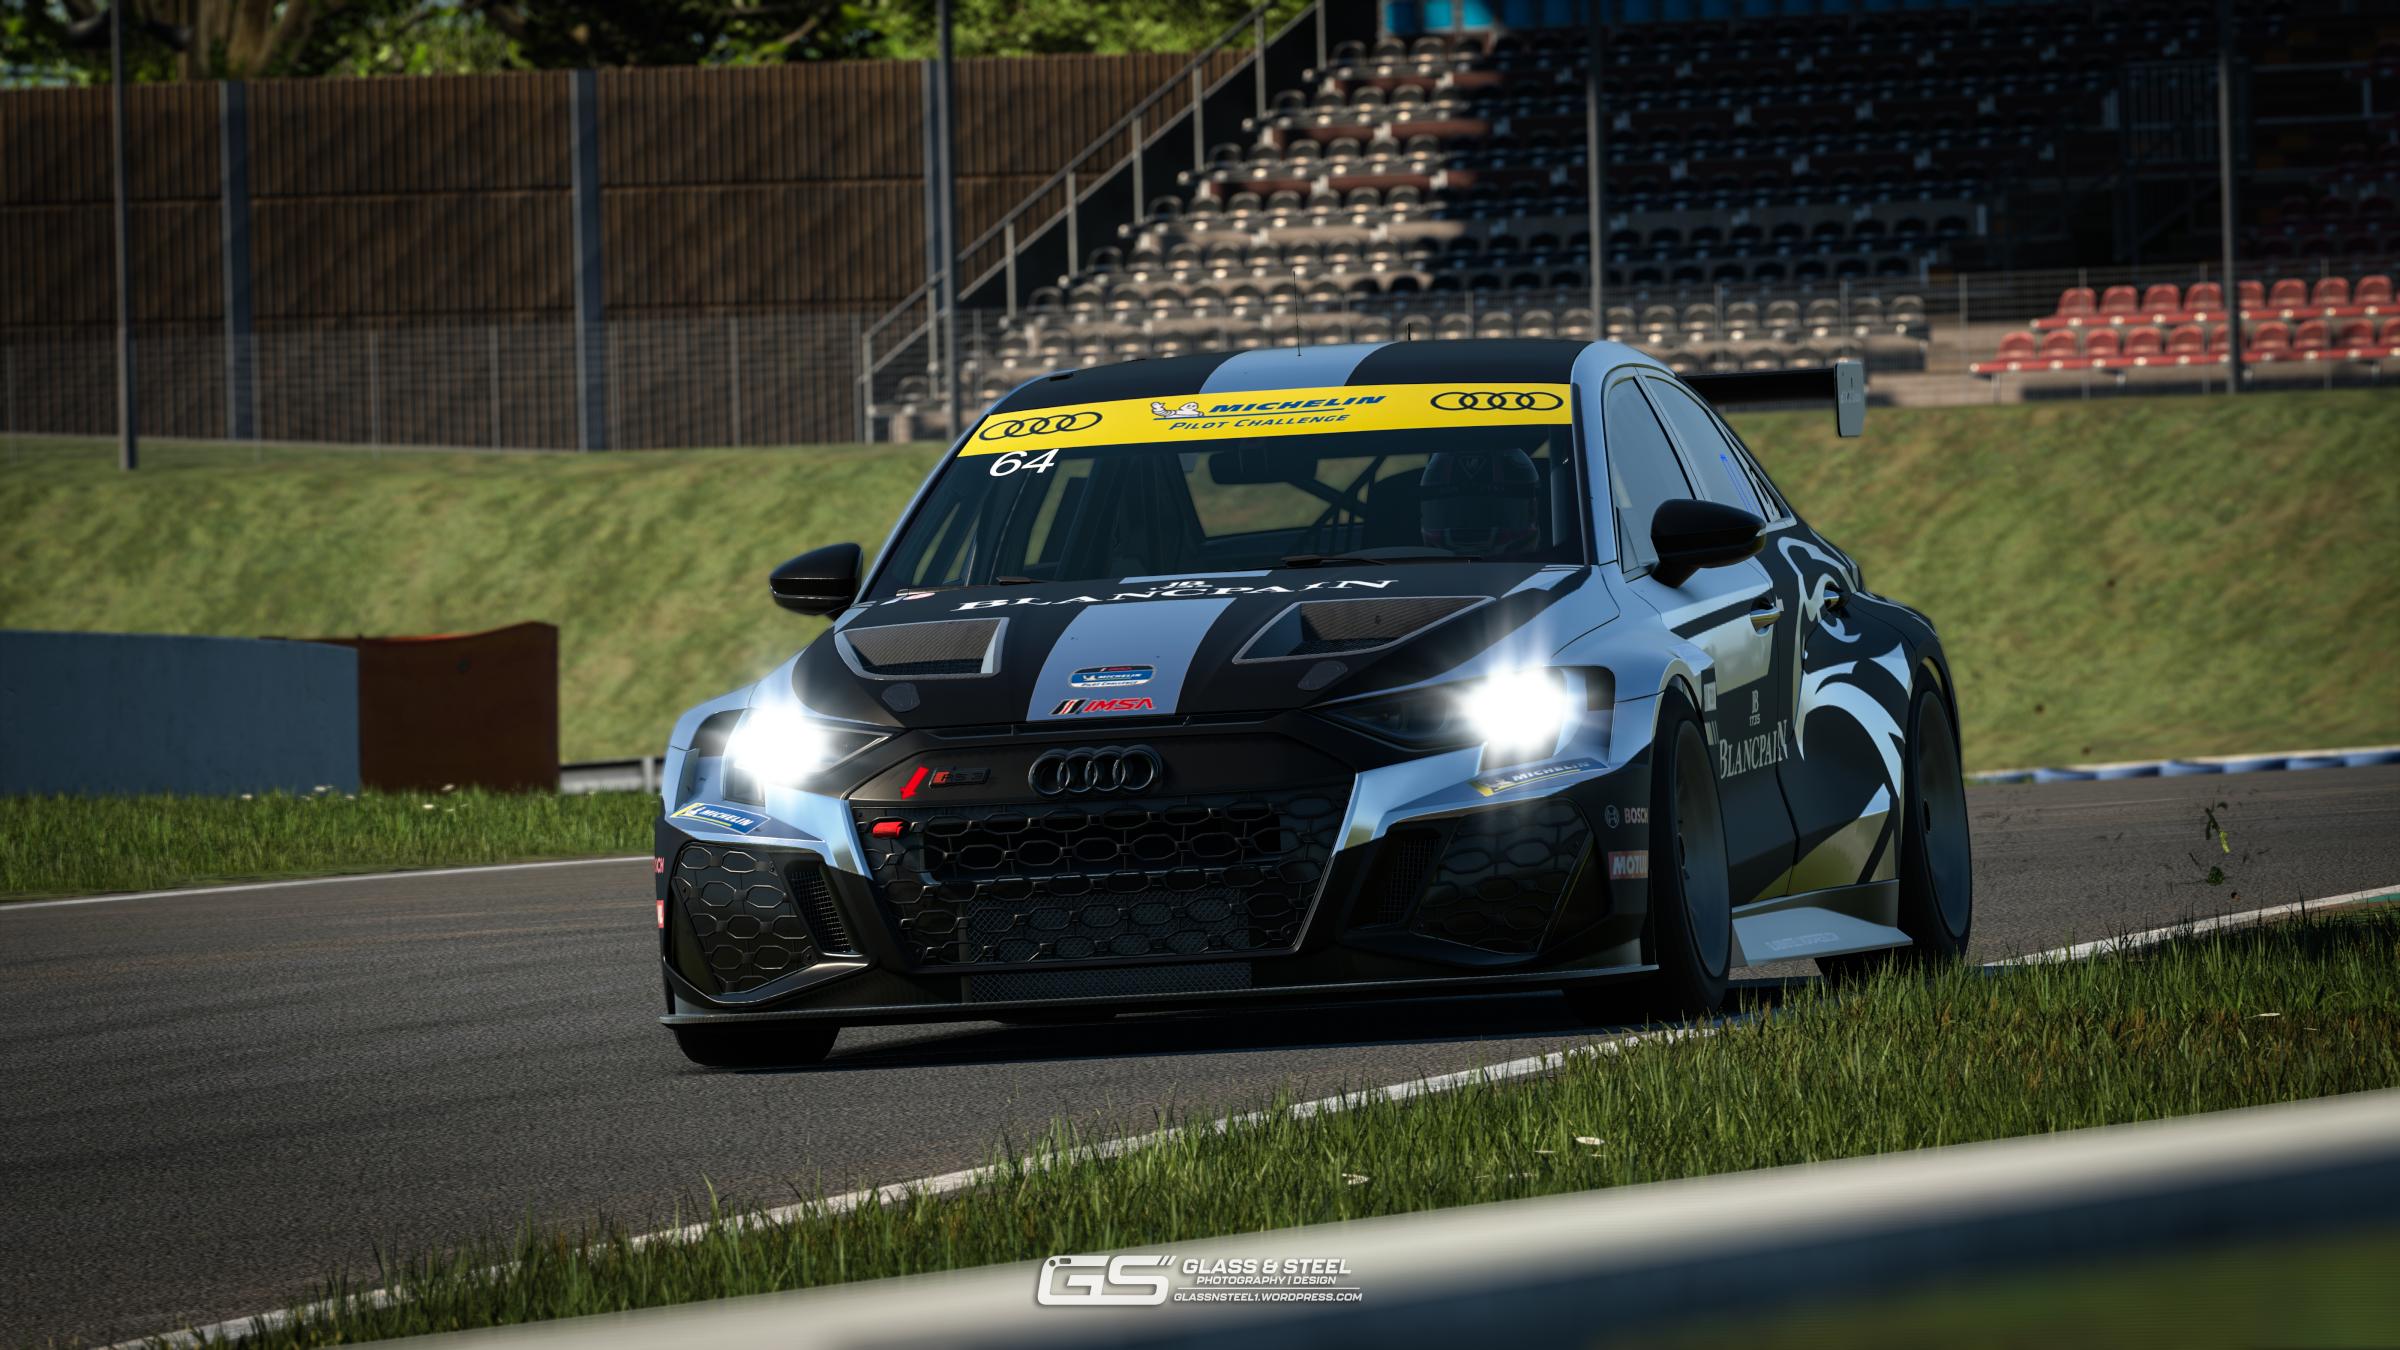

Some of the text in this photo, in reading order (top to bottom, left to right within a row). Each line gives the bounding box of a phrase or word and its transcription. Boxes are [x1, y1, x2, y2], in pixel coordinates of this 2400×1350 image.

[1209, 395, 1386, 413] MICHELIN
[1168, 414, 1350, 431] PILOT CHALLENGE
[989, 448, 1060, 477] 64
[950, 579, 1399, 612] BLANCPAIN
[1082, 697, 1154, 713] IMSA
[1719, 719, 1788, 780] BLANCPAIN
[1511, 761, 1591, 781] MICHELIN
[700, 808, 755, 827] MICHELIN
